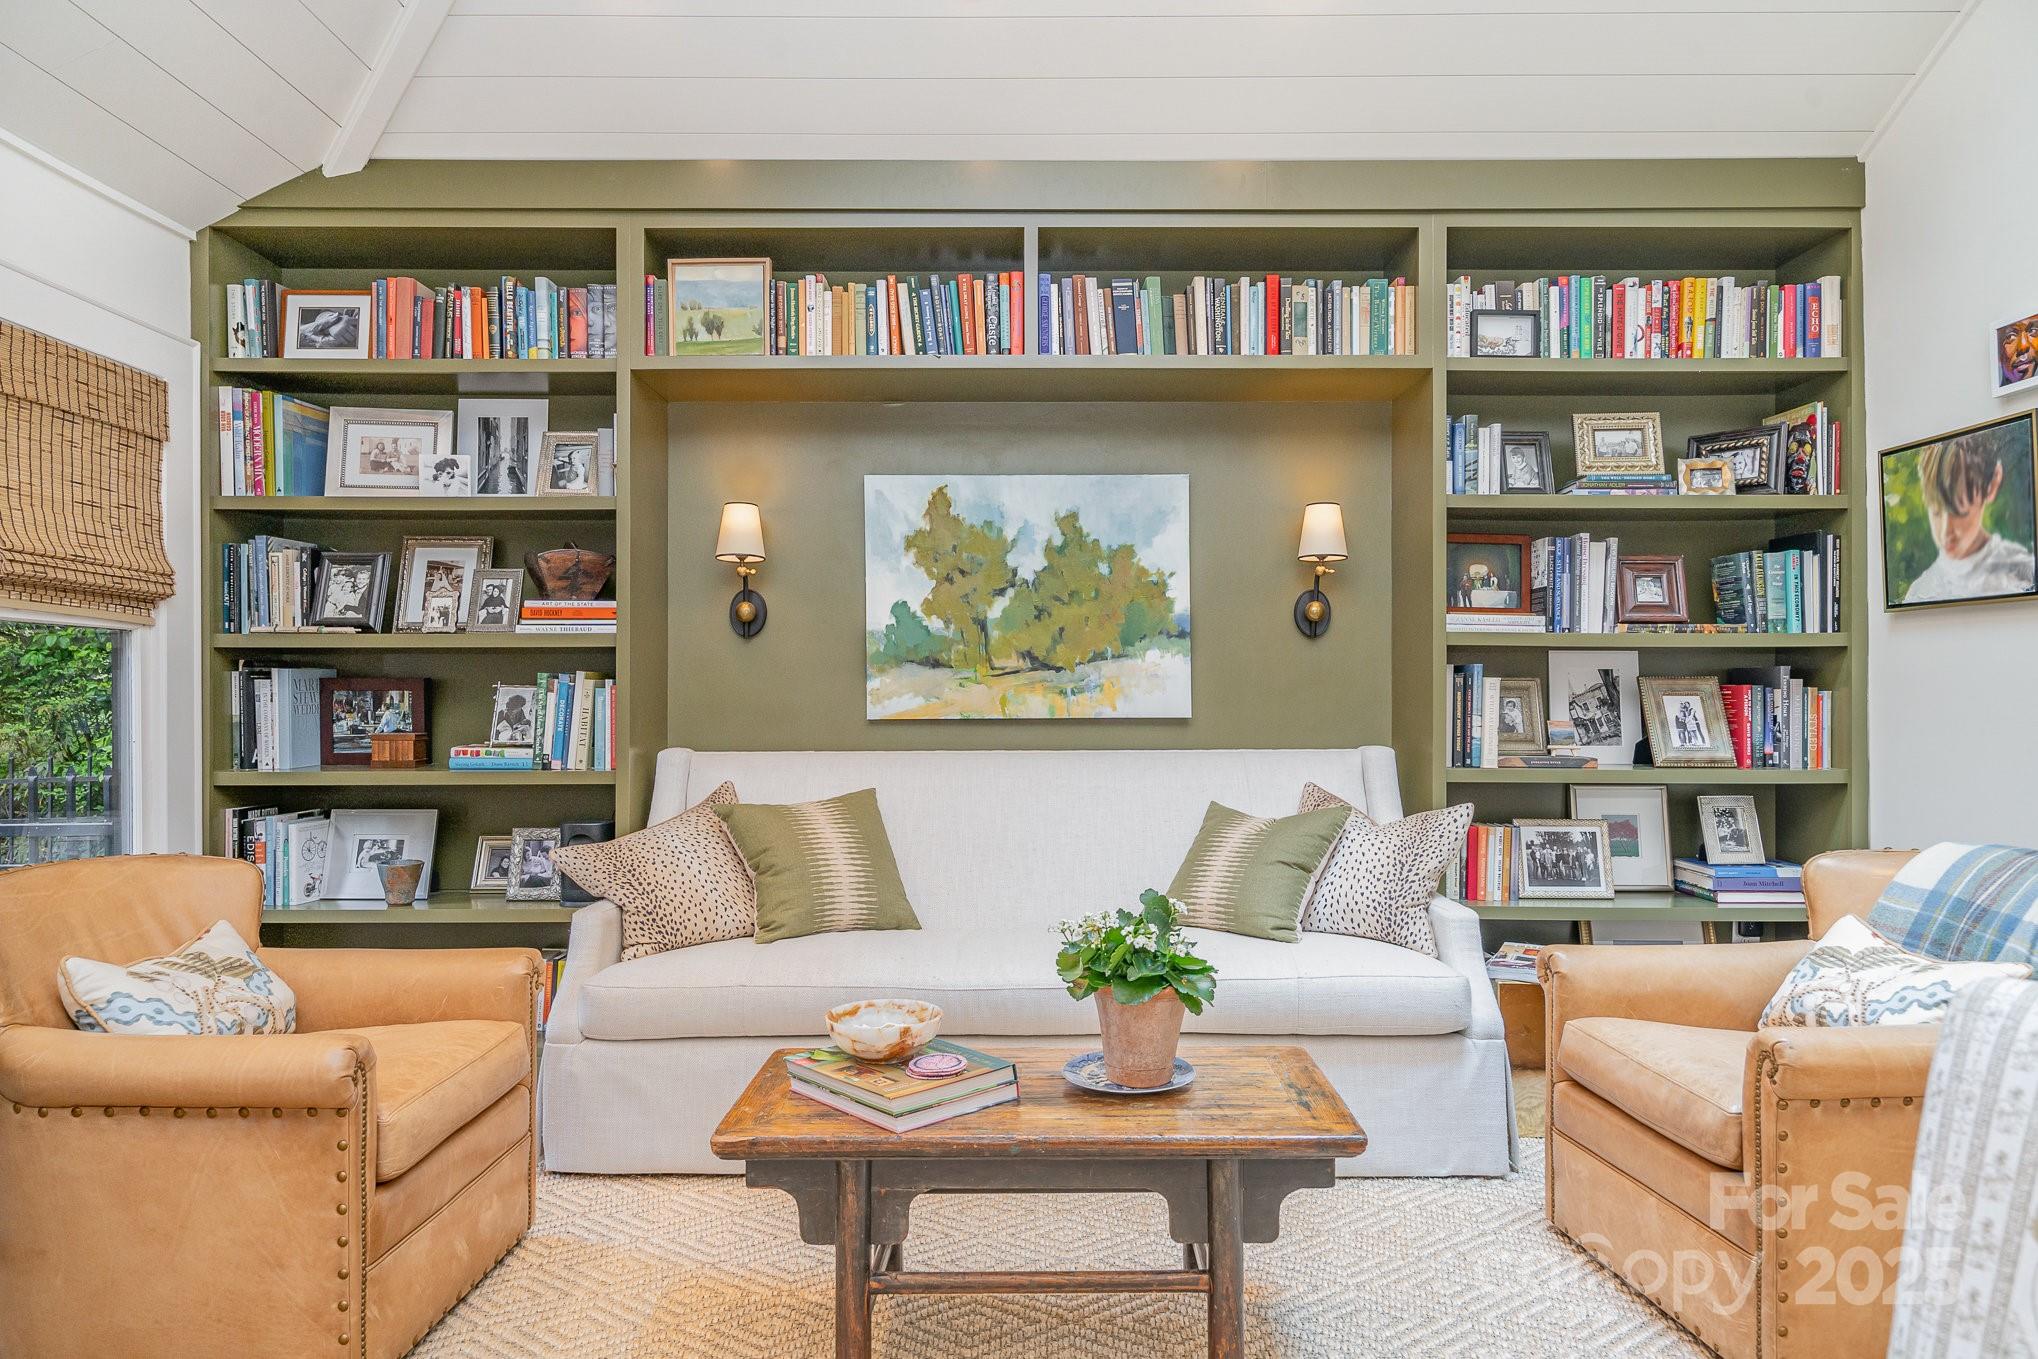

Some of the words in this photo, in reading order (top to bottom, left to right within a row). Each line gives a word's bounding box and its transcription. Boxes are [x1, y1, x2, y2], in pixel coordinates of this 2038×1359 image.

[506, 281, 514, 300] HELLO
[506, 300, 514, 332] BEAUTIFUL
[988, 315, 998, 346] Caste
[1214, 296, 1222, 342] WASHINGTON
[1811, 303, 1819, 333] ECHO
[253, 425, 262, 463] MODERN
[254, 464, 263, 482] MIX
[1755, 553, 1765, 568] KATE
[1755, 568, 1765, 596] ATKINSON
[1794, 694, 1802, 717] MADE
[578, 707, 590, 748] HABITAT
[1794, 723, 1802, 753] LIVING
